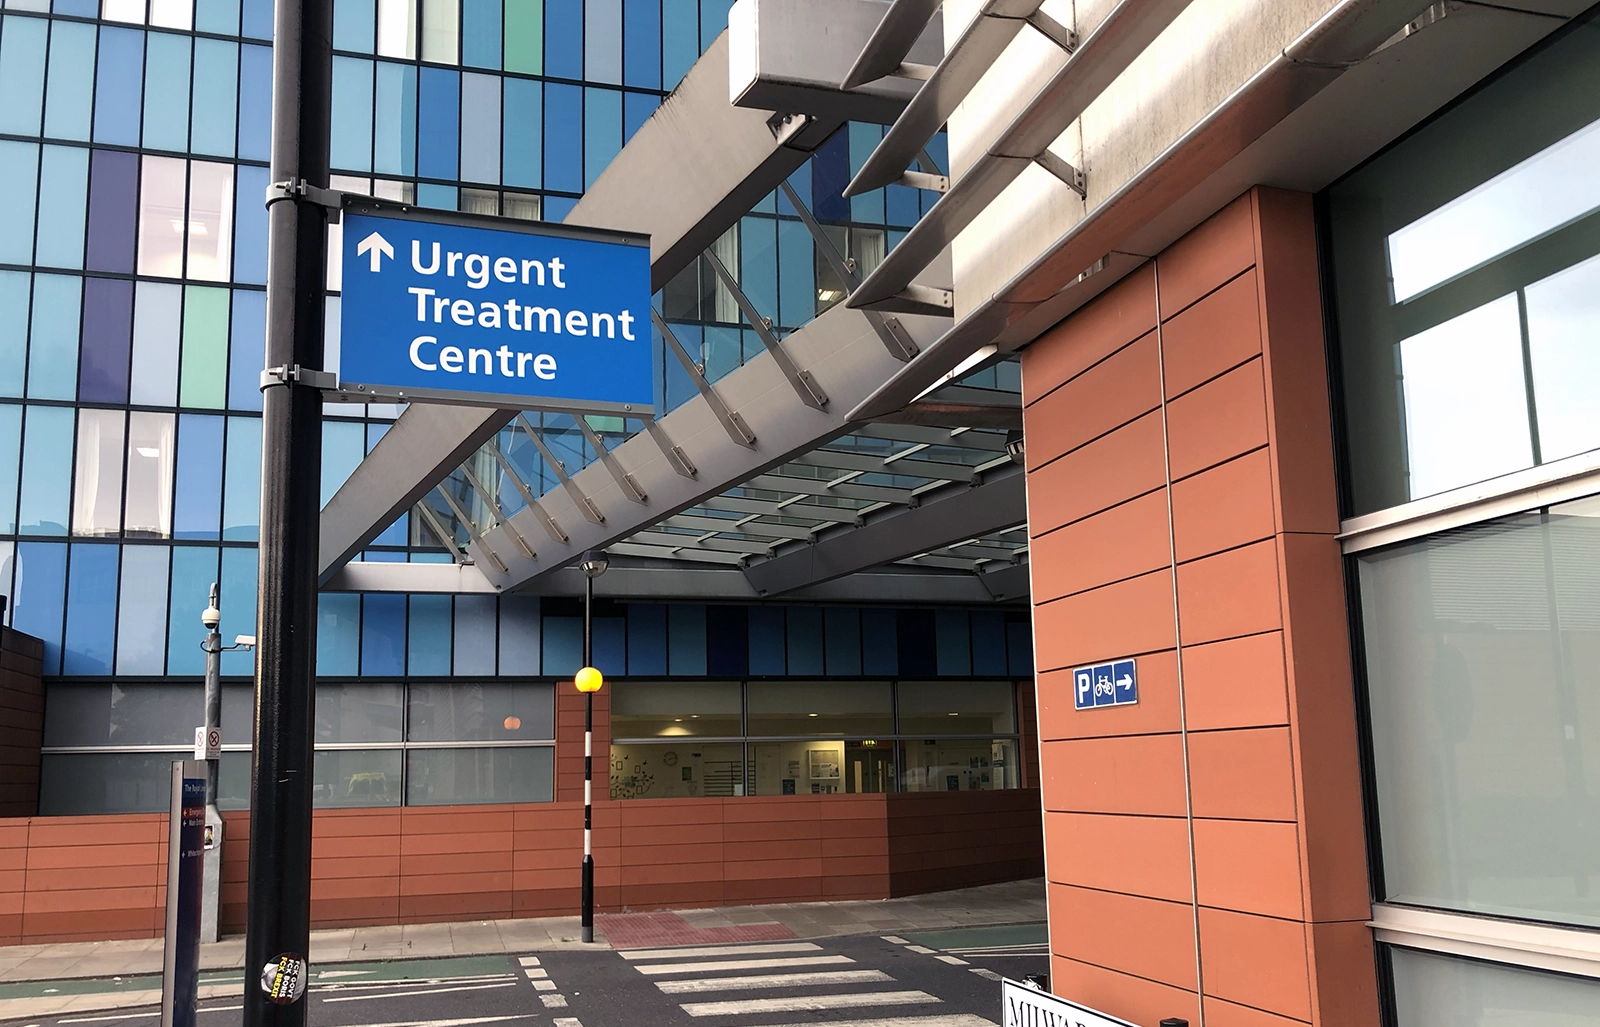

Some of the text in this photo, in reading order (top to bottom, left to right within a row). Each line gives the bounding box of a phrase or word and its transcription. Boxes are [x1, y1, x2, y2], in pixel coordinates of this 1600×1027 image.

[411, 240, 566, 289] Urgent
[408, 286, 635, 341] Treatment
[409, 335, 557, 380] Centre
[1078, 674, 1090, 703] P
[271, 957, 288, 998] FCK BREXIT
[279, 959, 294, 998] FCK BORIS
[1009, 996, 1086, 1027] MILW
